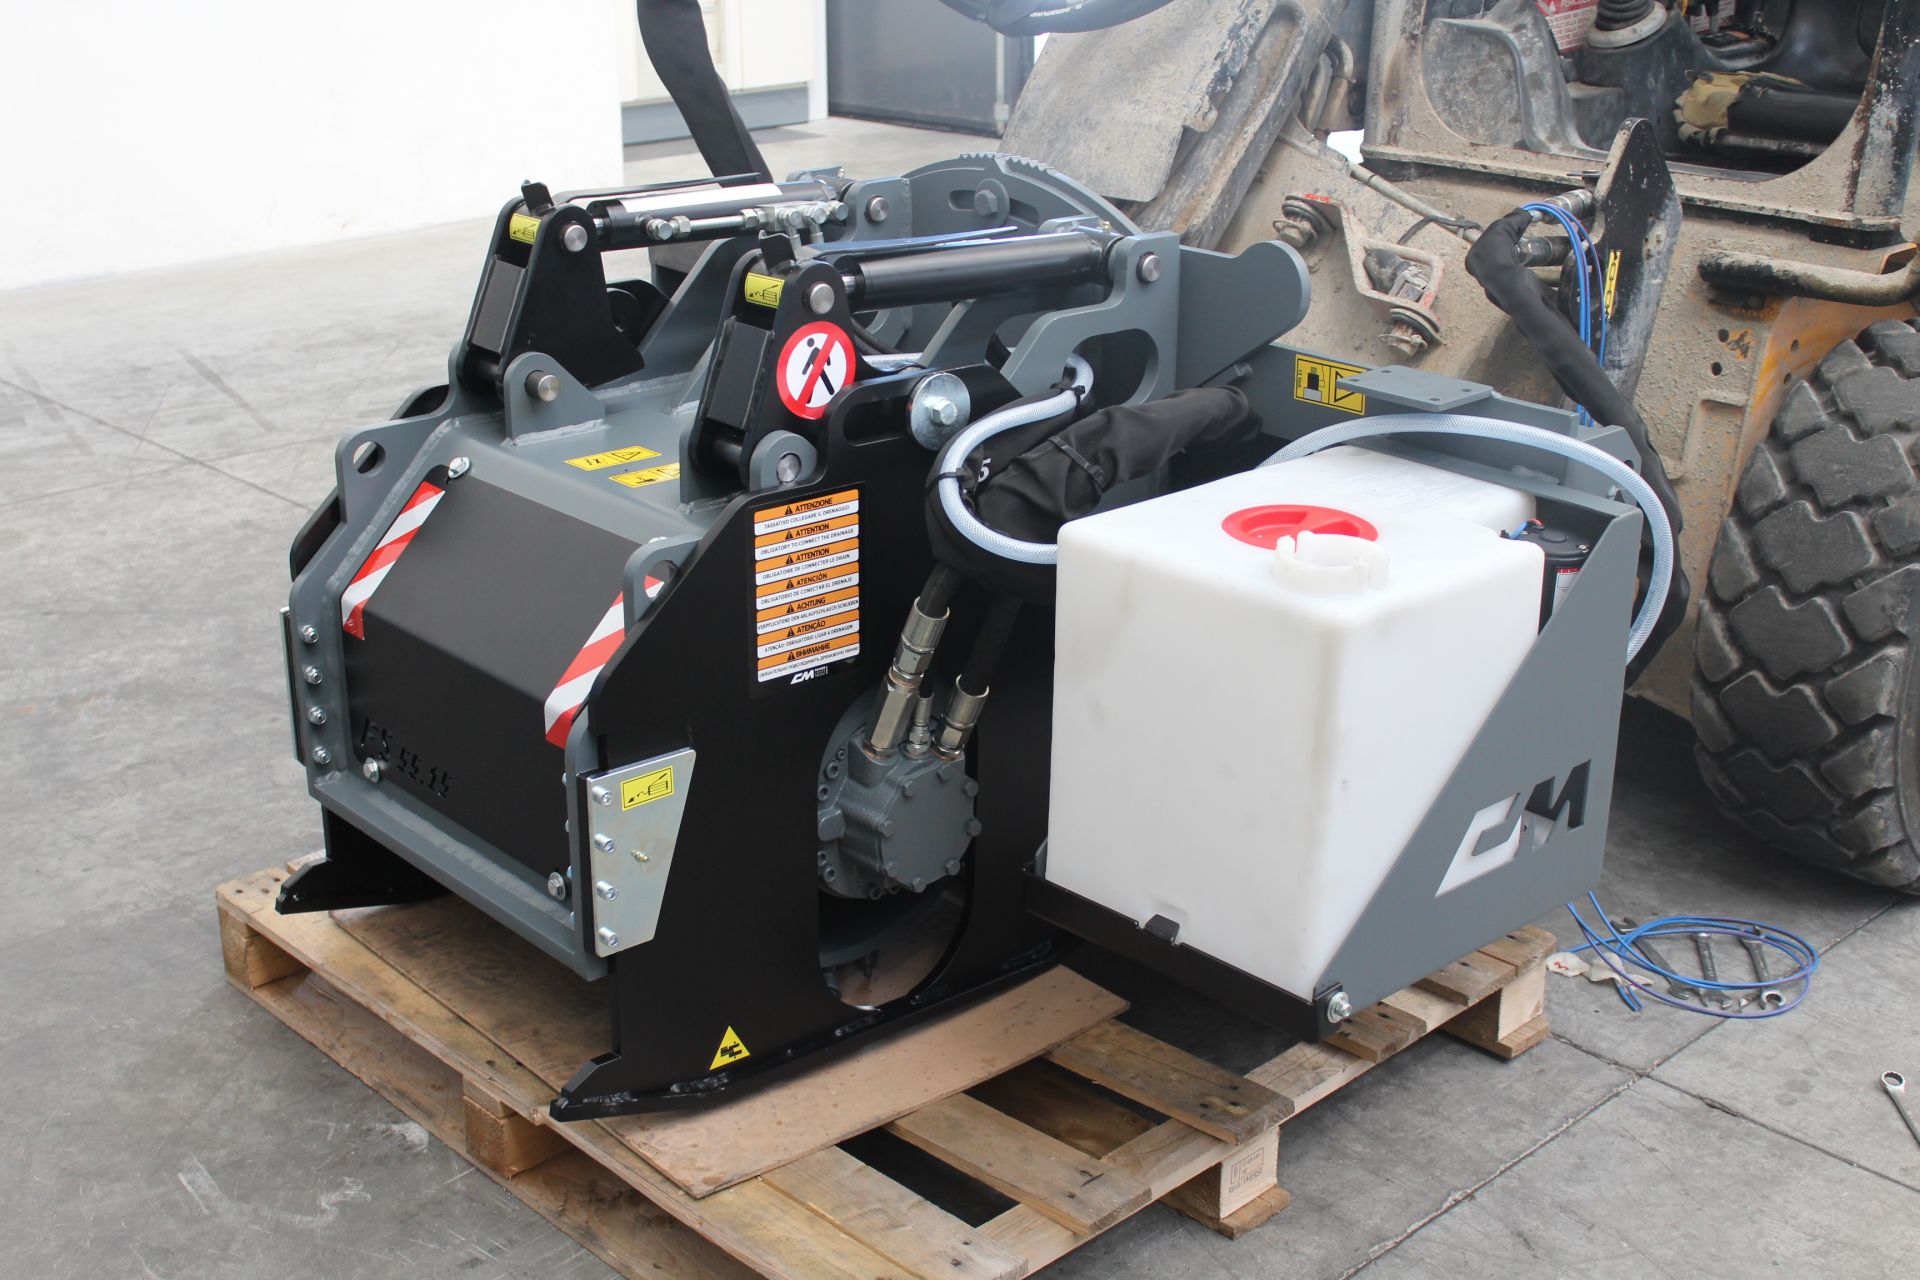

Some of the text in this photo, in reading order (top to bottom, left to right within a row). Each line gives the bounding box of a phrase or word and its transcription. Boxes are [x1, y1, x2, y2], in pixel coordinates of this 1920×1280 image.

[978, 458, 992, 482] 5
[795, 498, 832, 512] ATTENZIONE
[765, 519, 790, 529] TASSATIVO
[790, 512, 817, 523] COLLEGARE
[823, 505, 849, 516] DRENAGGIO
[796, 523, 829, 537] ATTENTION
[761, 544, 791, 555] OBLIGATORY
[799, 535, 821, 546] CONNECT
[831, 528, 854, 538] DRAINAGE
[796, 548, 829, 561] ATTENTION
[763, 568, 793, 580] OBLIGATOIRE
[802, 559, 829, 570] CONNECTER
[836, 554, 850, 562] DRAIN
[797, 572, 827, 586] ATENCIÓN
[761, 592, 792, 605] OBLIGATORIO
[801, 584, 825, 594] CONECTAR
[832, 578, 852, 587] DRENAJE
[797, 597, 826, 610] ACHTUNG
[797, 620, 825, 634] ATENÇÃO
[796, 643, 830, 657] ВНИМАНИЕ
[790, 670, 814, 684] CM
[397, 746, 453, 798] 55.15
[1434, 757, 1592, 898] CM
